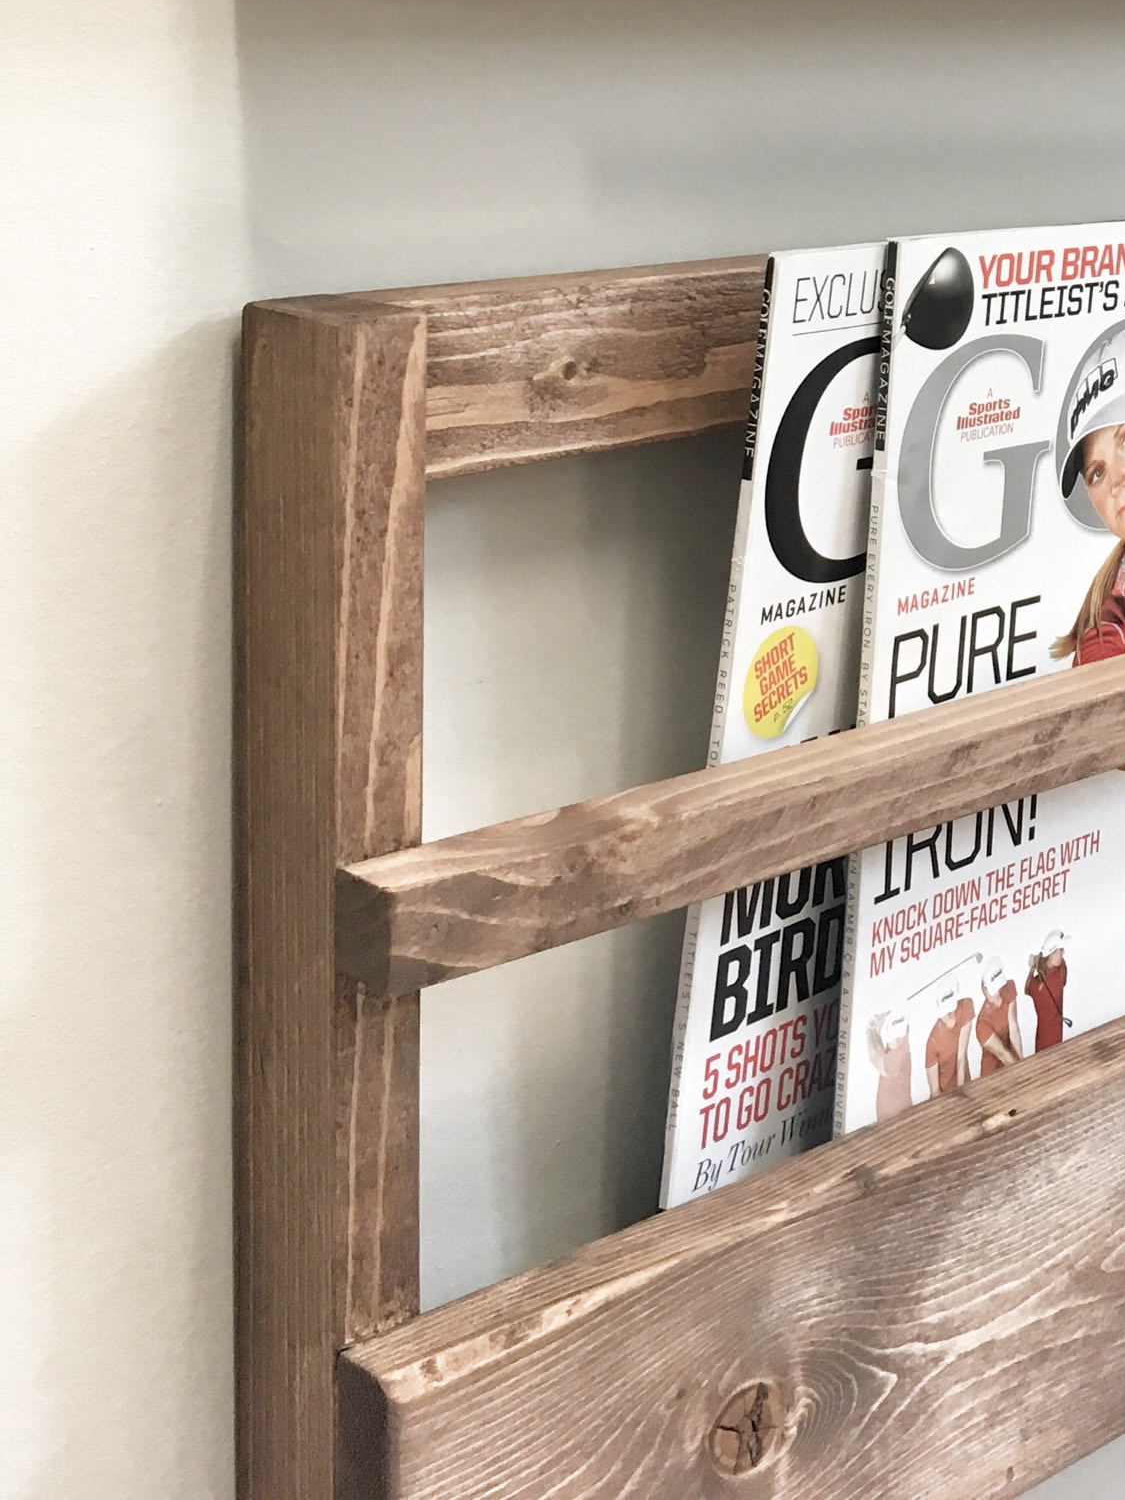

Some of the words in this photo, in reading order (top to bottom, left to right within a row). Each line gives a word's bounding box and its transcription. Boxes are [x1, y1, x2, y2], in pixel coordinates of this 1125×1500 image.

[978, 253, 1055, 289] YOUR
[980, 278, 1120, 327] TITLEIST'S
[956, 406, 1021, 431] Illustrated
[968, 397, 1011, 417] Sports
[960, 422, 1014, 444] PUBLICATION
[868, 505, 880, 546] PURE
[864, 553, 877, 605] EVERY
[897, 577, 975, 616] MAGAZINE
[720, 584, 736, 660] PATRICK
[761, 584, 847, 626] MAGAZINE
[754, 632, 795, 680] SHORT
[759, 655, 797, 697] GAME
[860, 663, 870, 683] BY
[888, 595, 1041, 719] PURE
[714, 670, 728, 714] REED
[754, 666, 808, 723] SECRETS
[871, 898, 928, 948] KNOCK
[932, 876, 981, 920] DOWN
[986, 862, 1016, 896] THE
[1020, 847, 1056, 884] FLAG
[1060, 829, 1101, 866] WITH
[846, 882, 858, 948] KAYMER
[870, 942, 896, 978] MY
[900, 895, 1007, 964] SQUARE-FACE
[1012, 868, 1070, 914] SECRET
[679, 931, 697, 1032] TITLEIST'S
[709, 904, 846, 1043] BIRD
[672, 1040, 685, 1081] NEW
[702, 1053, 722, 1100] 5
[725, 1013, 807, 1091] SHOTS
[668, 1089, 681, 1131] BALL
[700, 1093, 731, 1149] TO
[737, 1077, 772, 1133] GO
[692, 1155, 724, 1193] By
[729, 1129, 776, 1173] Tour
